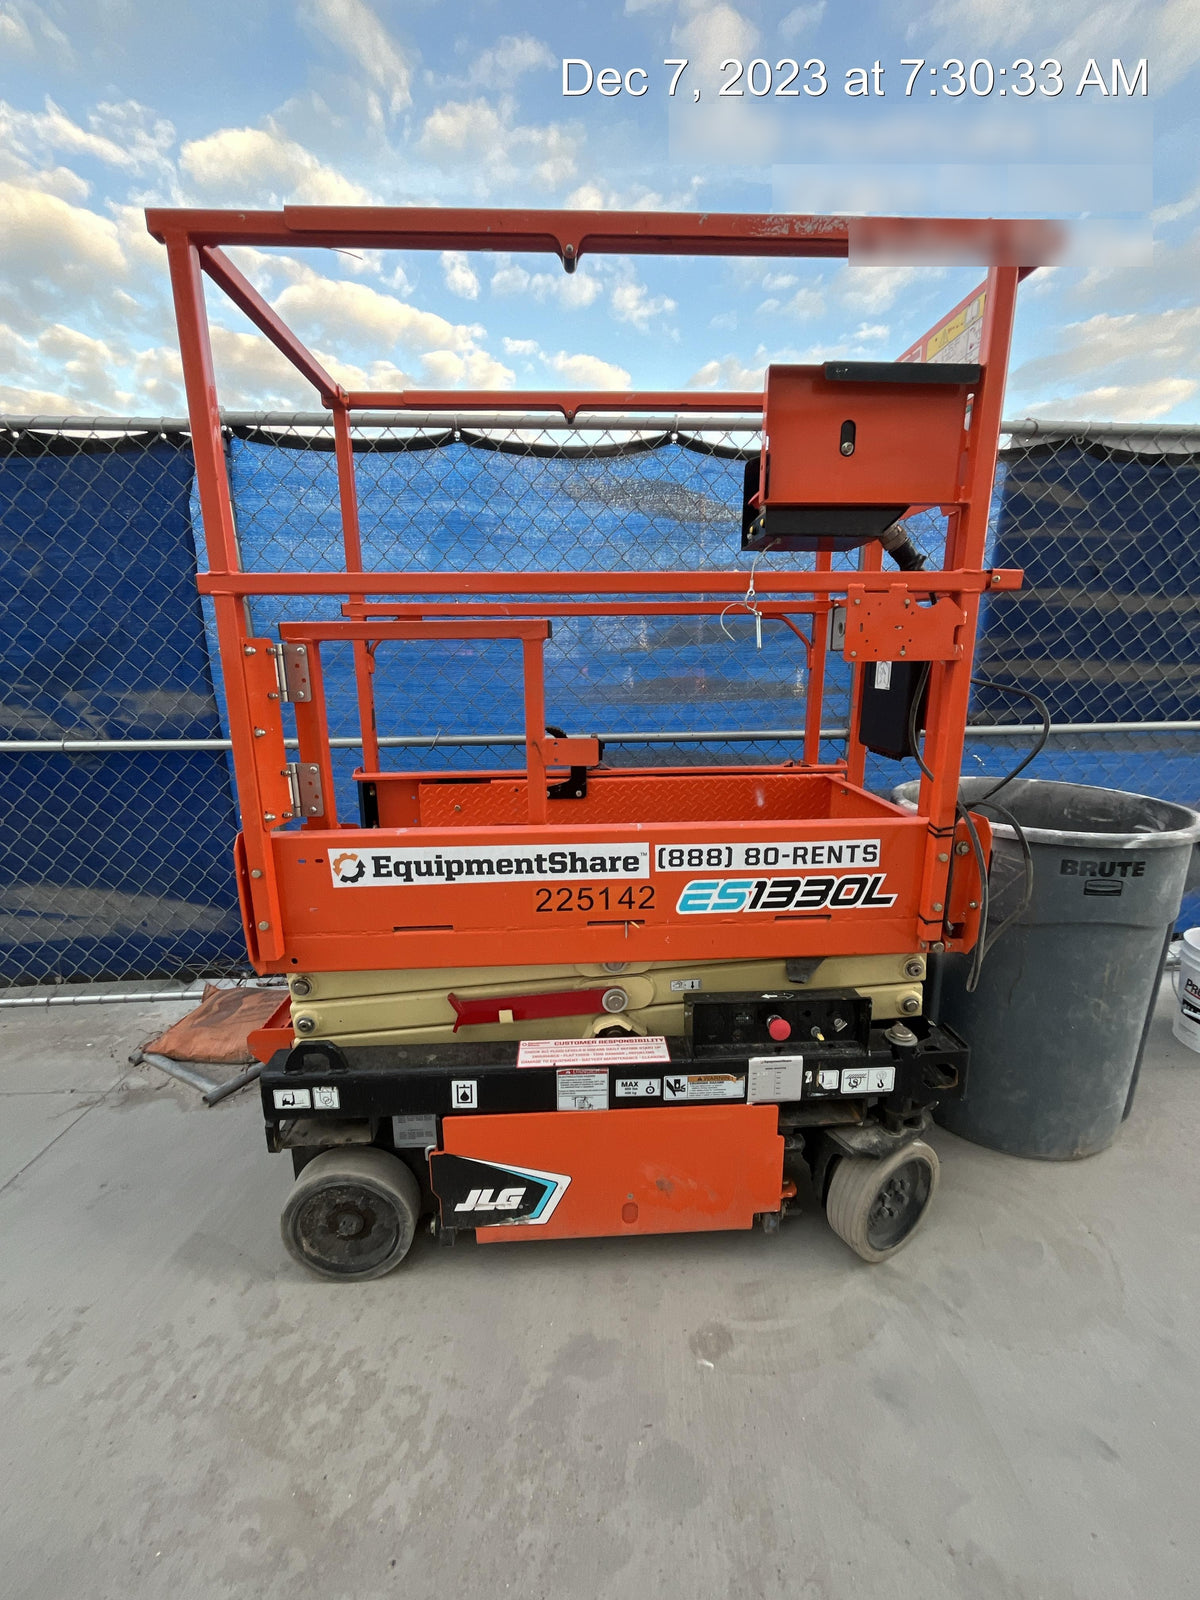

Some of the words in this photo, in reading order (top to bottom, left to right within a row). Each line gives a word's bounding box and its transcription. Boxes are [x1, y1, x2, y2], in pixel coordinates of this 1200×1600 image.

[657, 847, 733, 868] (888)
[744, 844, 878, 866] 80-RENTS
[1059, 859, 1146, 878] BRUTE
[535, 886, 656, 912] 225142
[677, 874, 898, 913] ES1330L
[598, 1037, 664, 1045] RESPONSIBILITY
[454, 1187, 527, 1212] JLG
